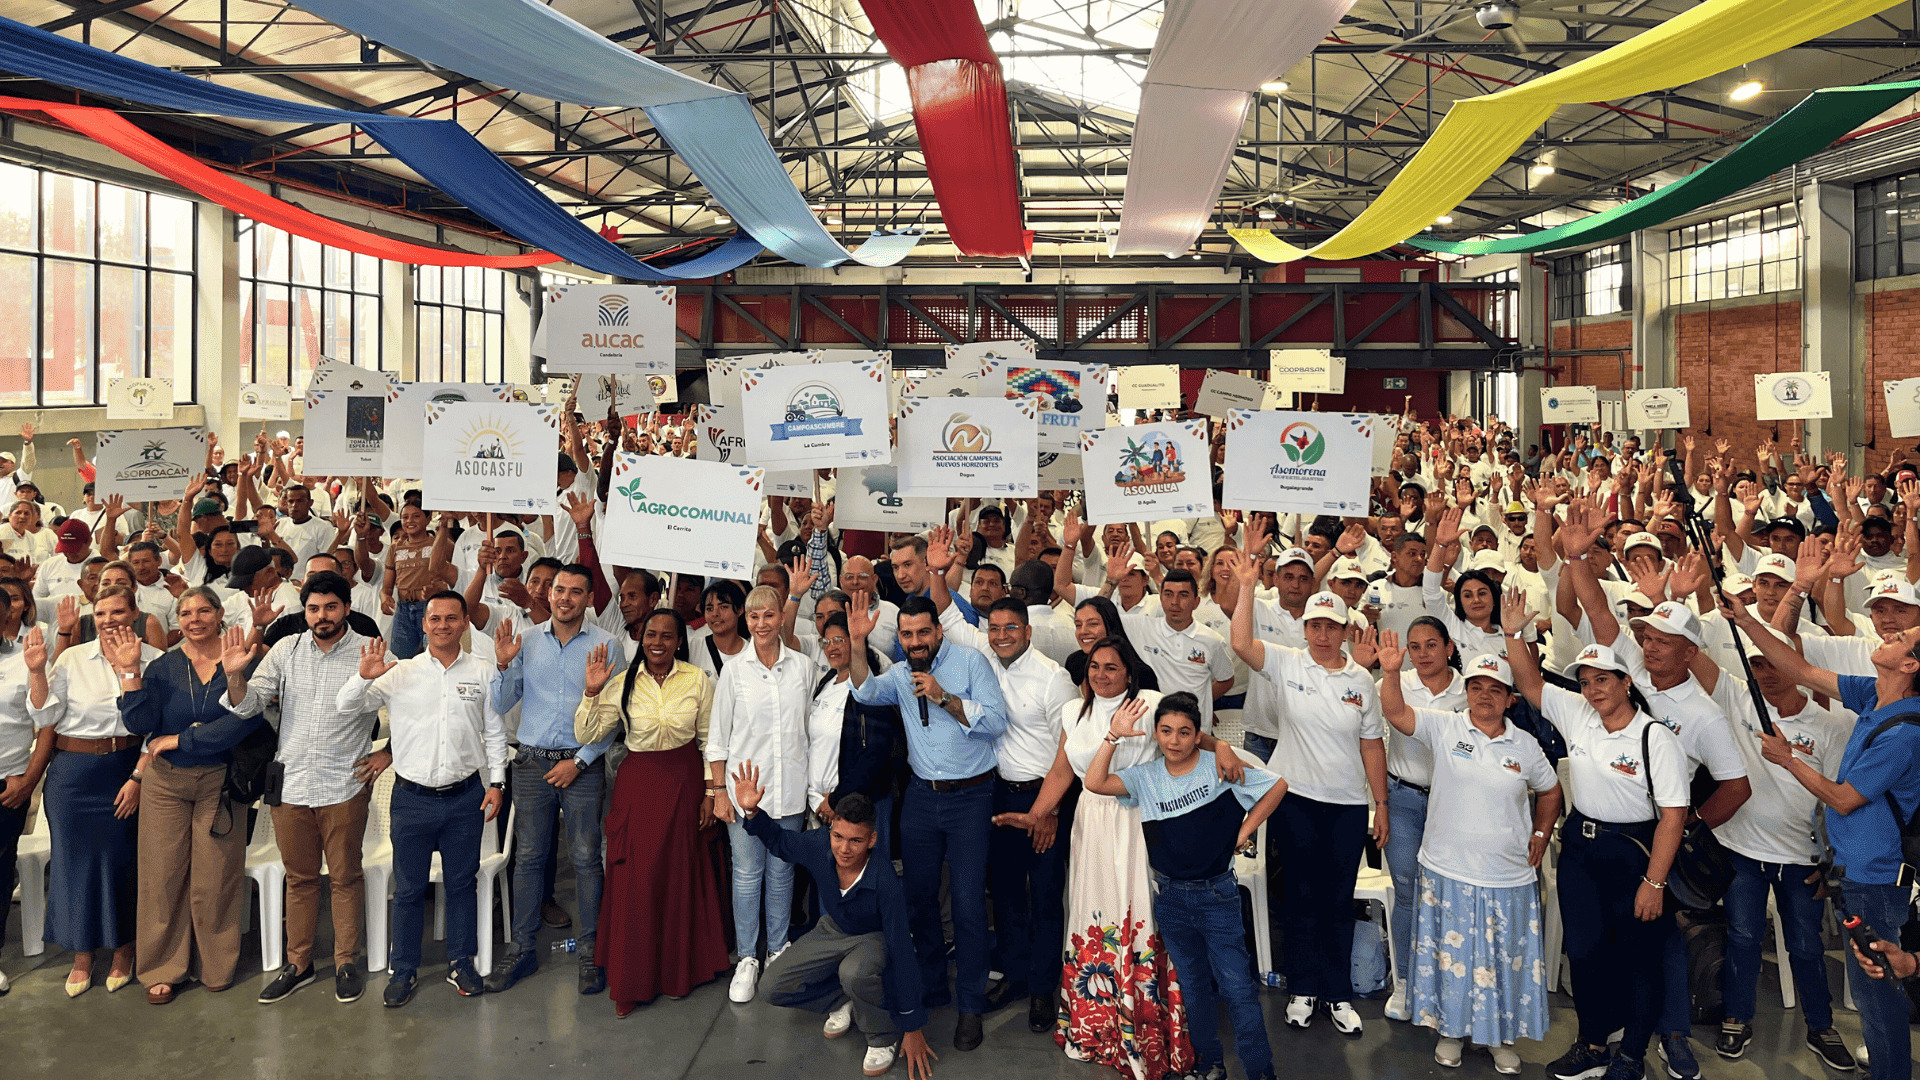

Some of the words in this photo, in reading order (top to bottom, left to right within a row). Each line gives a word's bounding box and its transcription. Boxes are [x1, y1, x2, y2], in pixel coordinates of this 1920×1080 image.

[787, 421, 845, 431] CAMPOASCUMBRE
[115, 467, 190, 479] ASOPROACAM
[455, 460, 523, 477] ASOCASFU
[1269, 463, 1327, 477] Asomorena
[1123, 482, 1179, 497] ASOVILLA
[636, 501, 753, 525] AGROCOMUNAL
